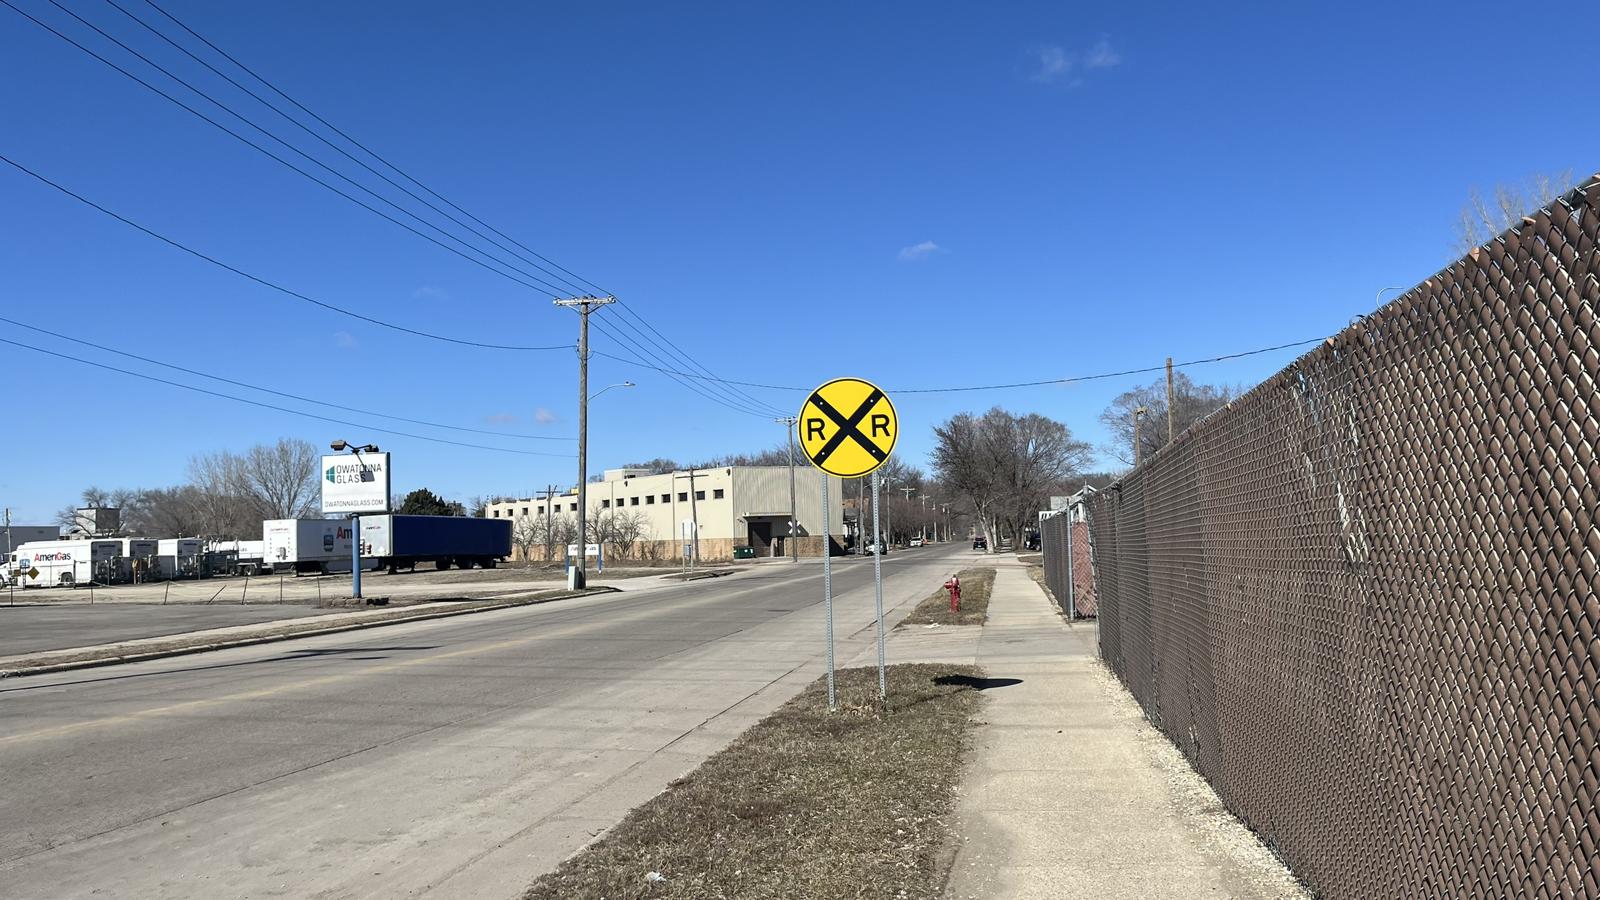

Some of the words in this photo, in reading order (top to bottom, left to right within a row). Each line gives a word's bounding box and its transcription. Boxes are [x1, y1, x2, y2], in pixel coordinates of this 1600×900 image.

[807, 418, 826, 441] R
[871, 414, 890, 437] R
[336, 464, 382, 474] OWATONNA
[336, 474, 366, 484] GLASS
[34, 552, 71, 562] AmeriGas
